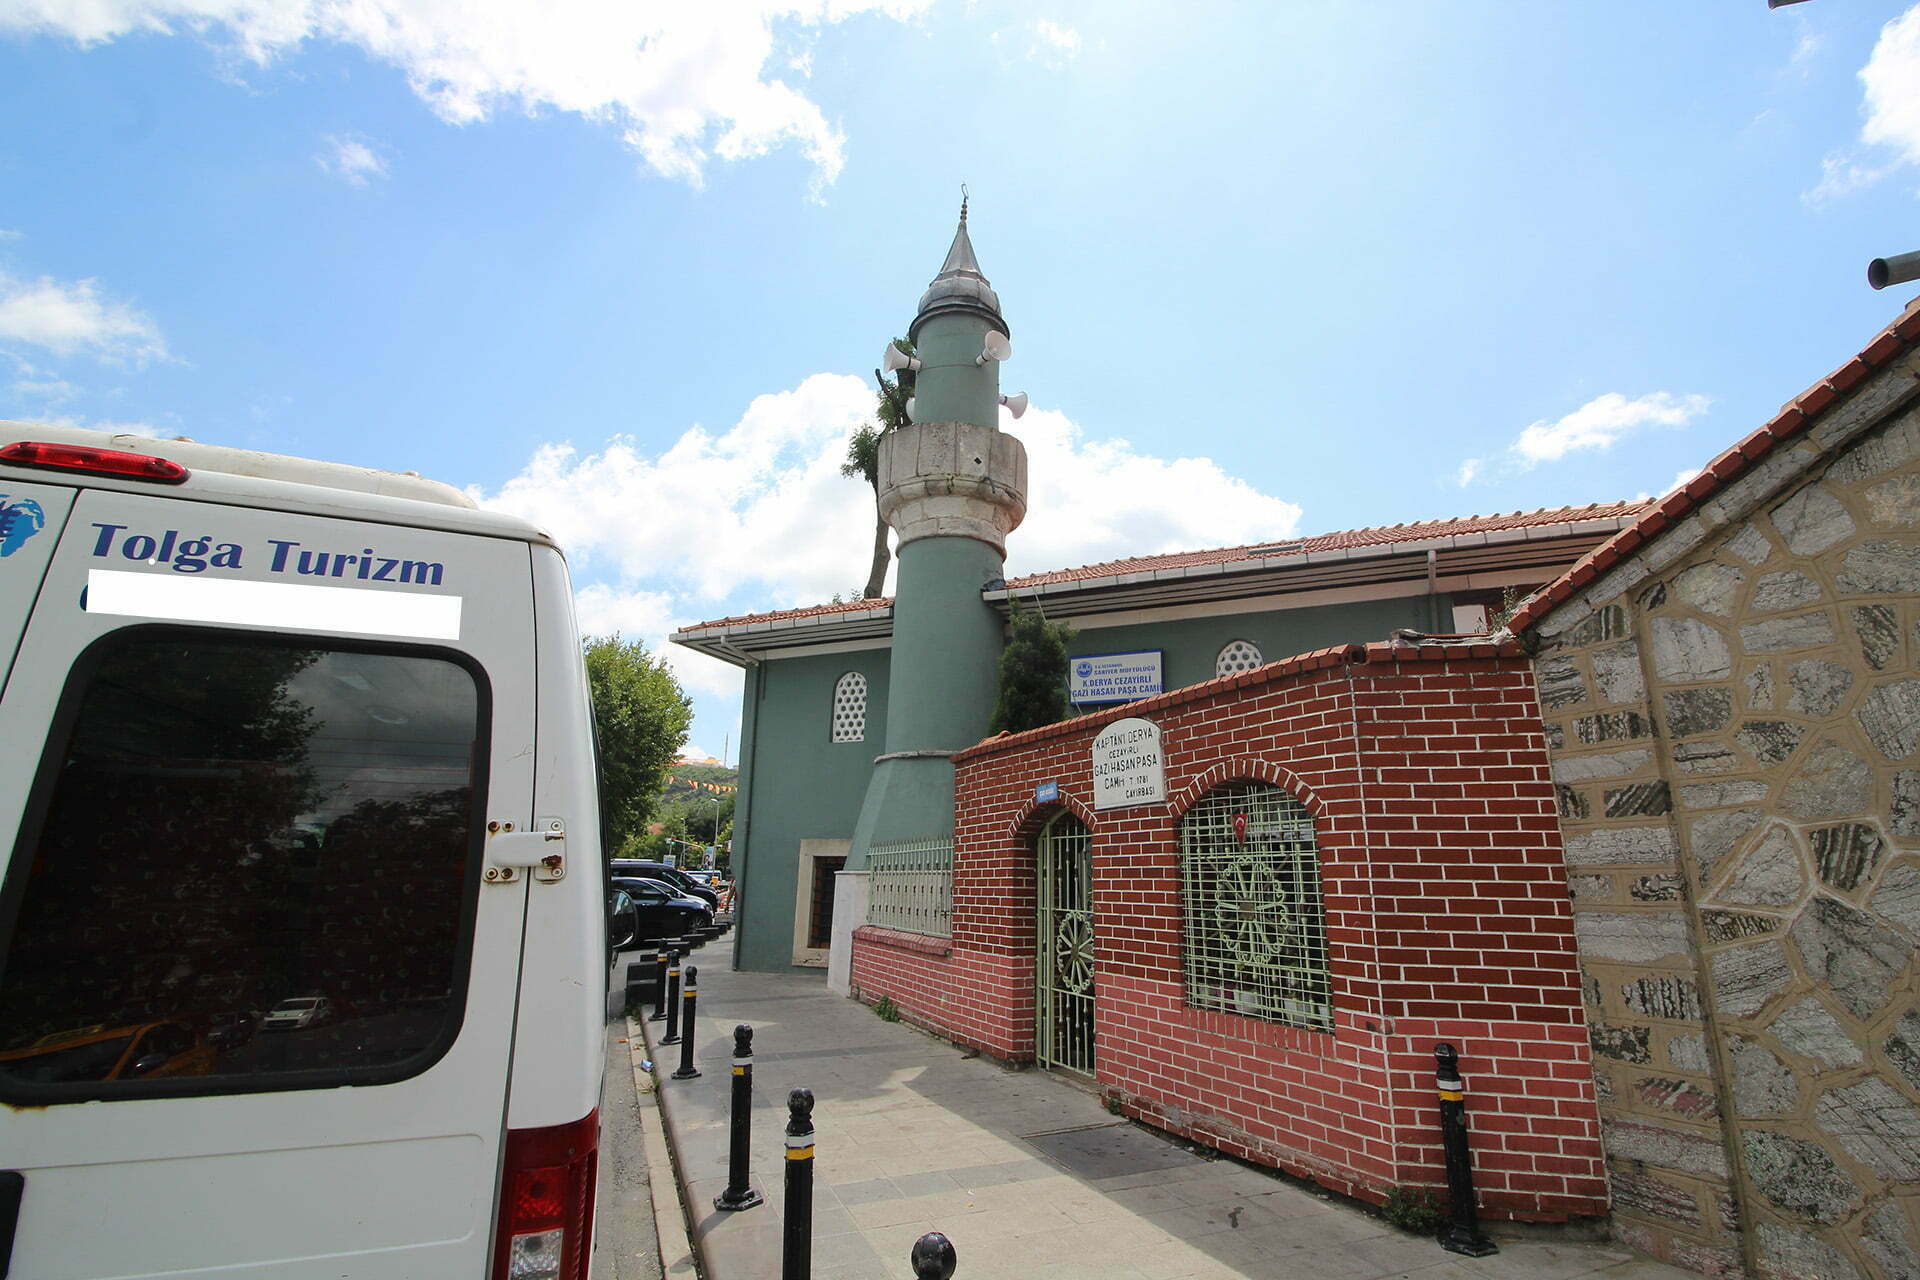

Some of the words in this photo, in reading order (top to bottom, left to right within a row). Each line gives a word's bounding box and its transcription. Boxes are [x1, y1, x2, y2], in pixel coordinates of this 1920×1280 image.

[91, 523, 243, 573] Tolga
[267, 539, 445, 586] Turizm
[1090, 687, 1116, 696] HASAN
[1128, 727, 1153, 743] DERYA
